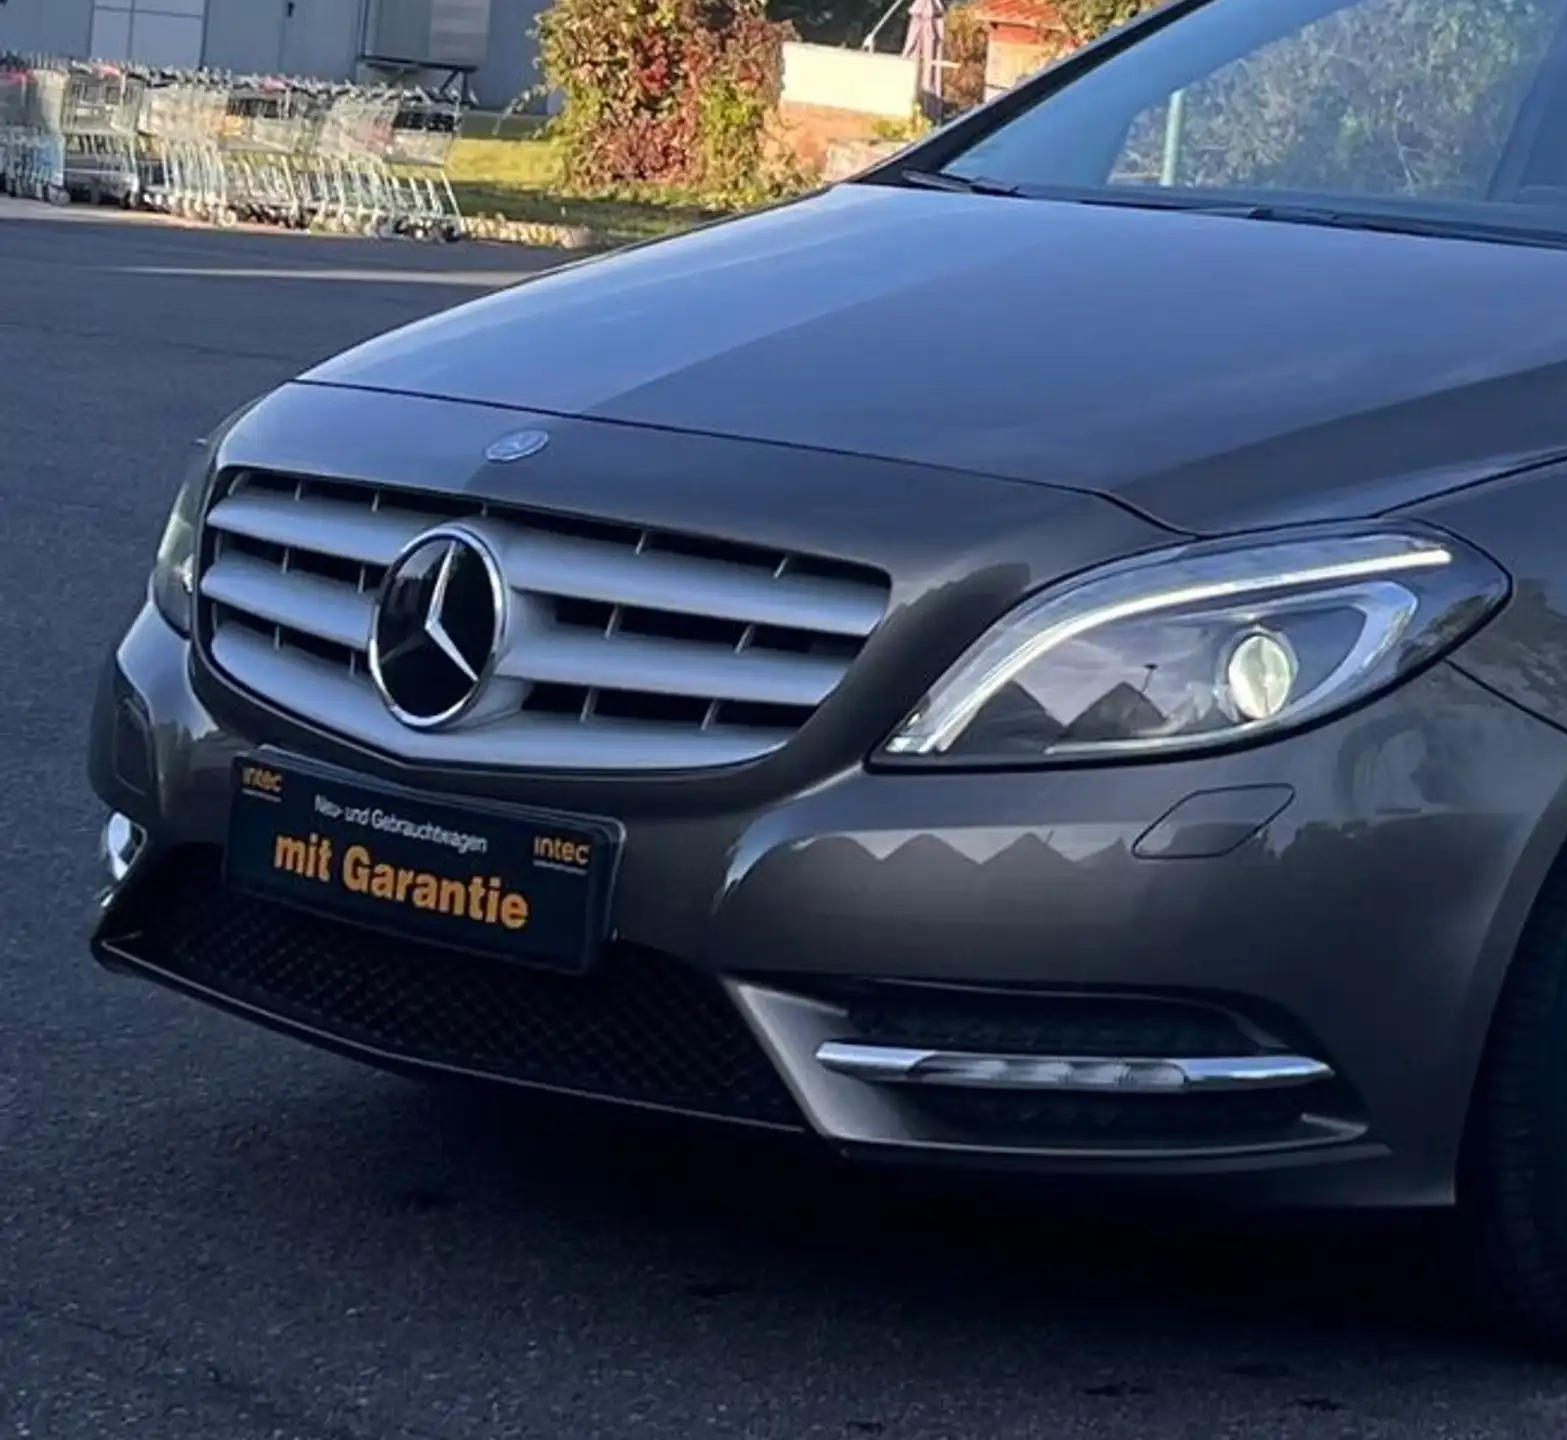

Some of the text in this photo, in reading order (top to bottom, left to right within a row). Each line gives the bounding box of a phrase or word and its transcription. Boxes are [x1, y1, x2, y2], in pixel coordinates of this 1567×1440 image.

[344, 807, 370, 826] und
[371, 809, 488, 854] Gebrauchtwagen
[273, 831, 530, 930] mit Garantie
